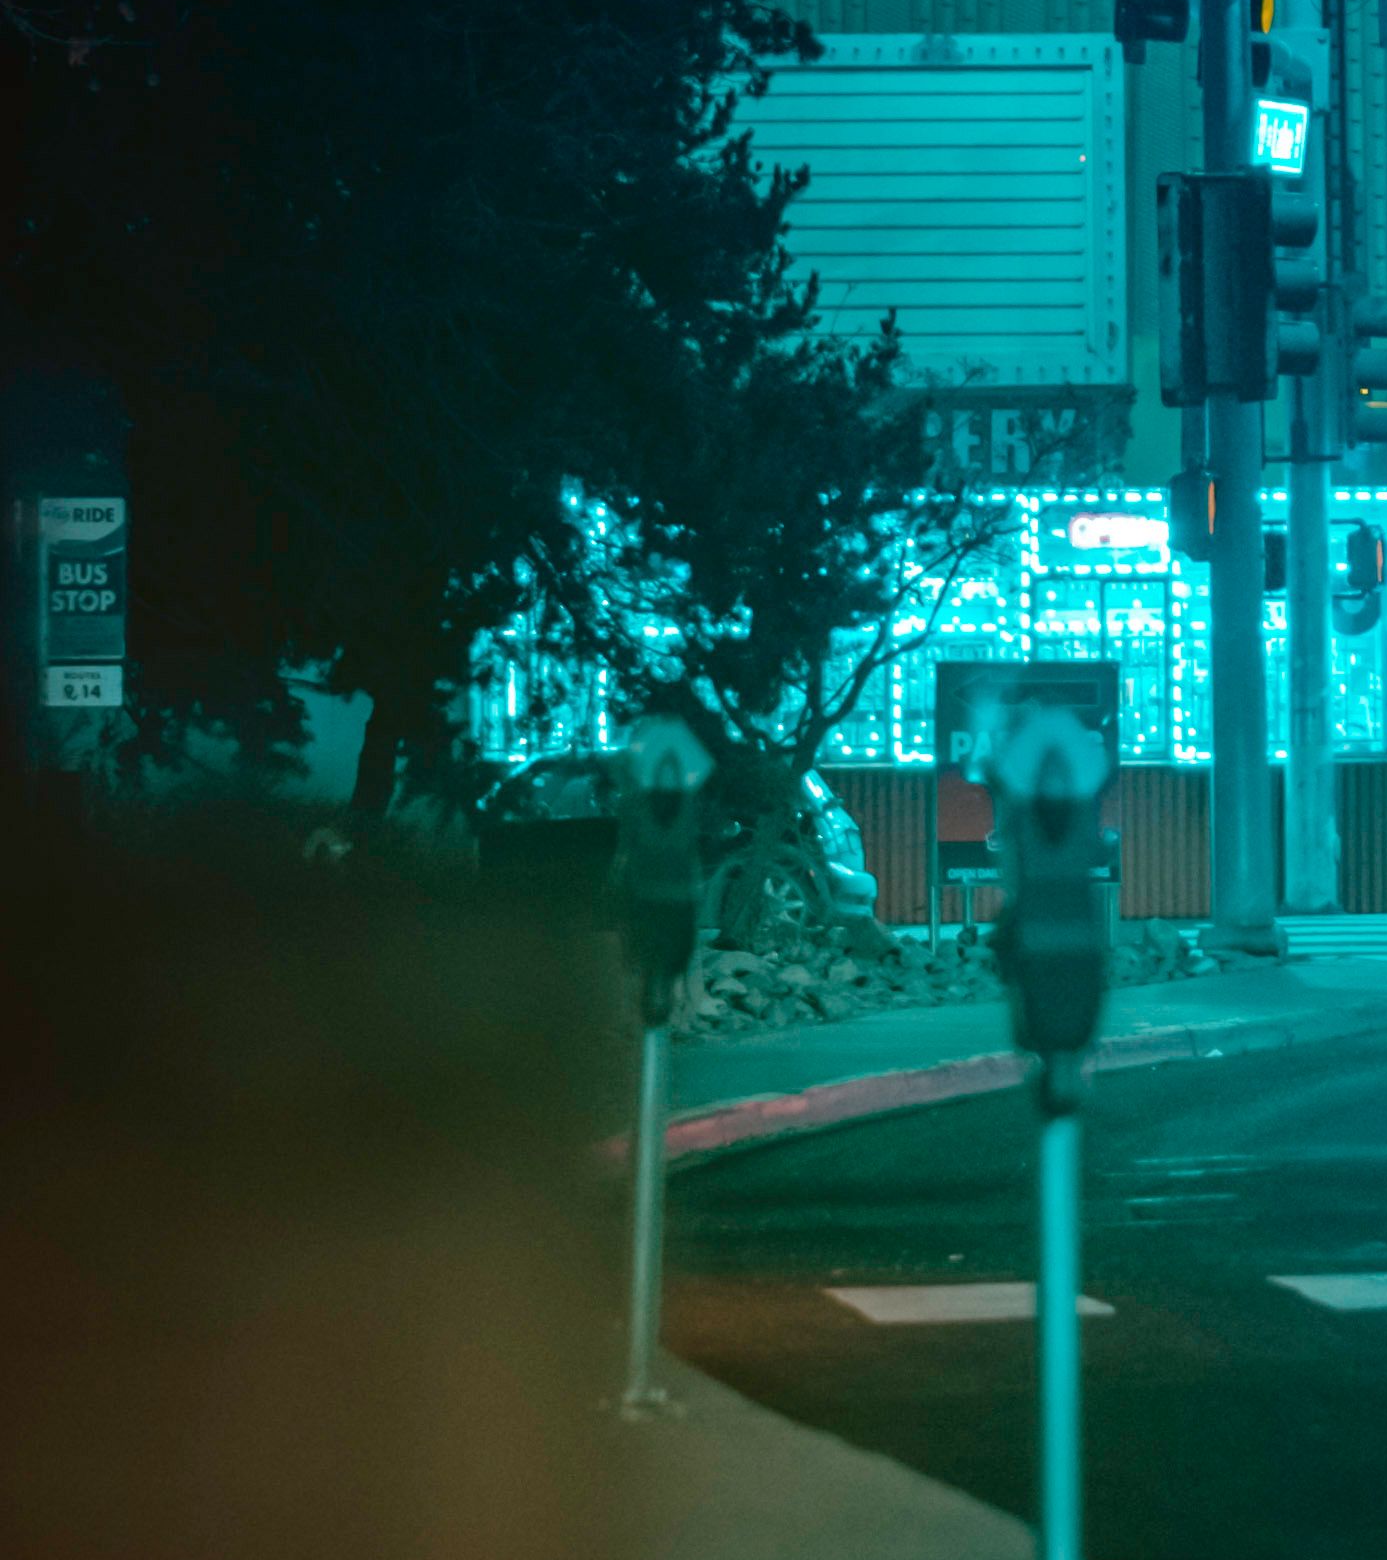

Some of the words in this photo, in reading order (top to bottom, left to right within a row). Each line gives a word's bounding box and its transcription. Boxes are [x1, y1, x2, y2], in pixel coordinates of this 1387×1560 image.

[73, 507, 115, 523] RIDE
[58, 562, 108, 585] BUS
[51, 589, 117, 612] STOP
[82, 684, 101, 699] 14
